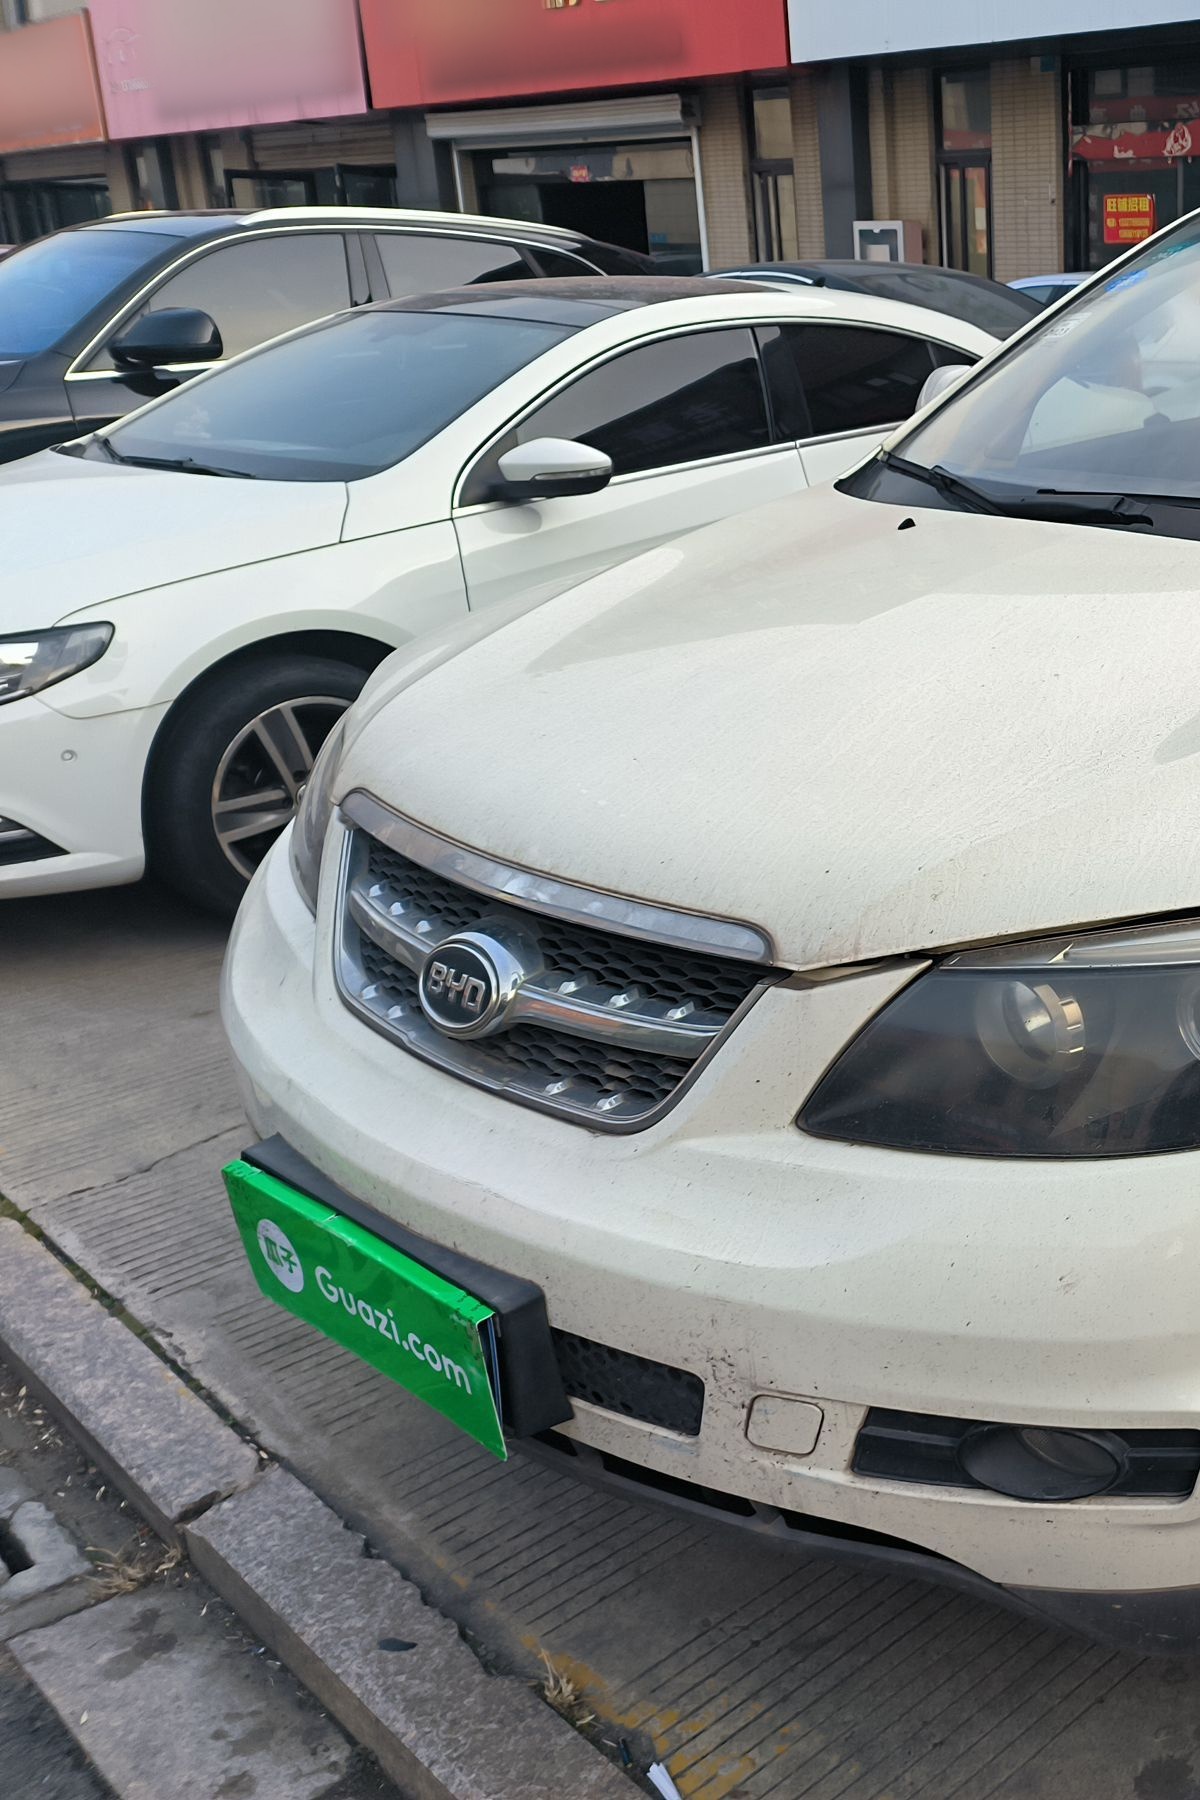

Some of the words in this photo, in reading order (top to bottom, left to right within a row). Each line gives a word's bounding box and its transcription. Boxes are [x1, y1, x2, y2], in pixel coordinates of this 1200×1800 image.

[428, 961, 486, 1014] BYD
[262, 1234, 298, 1274] 瓜子
[314, 1265, 473, 1395] Guazi.com
